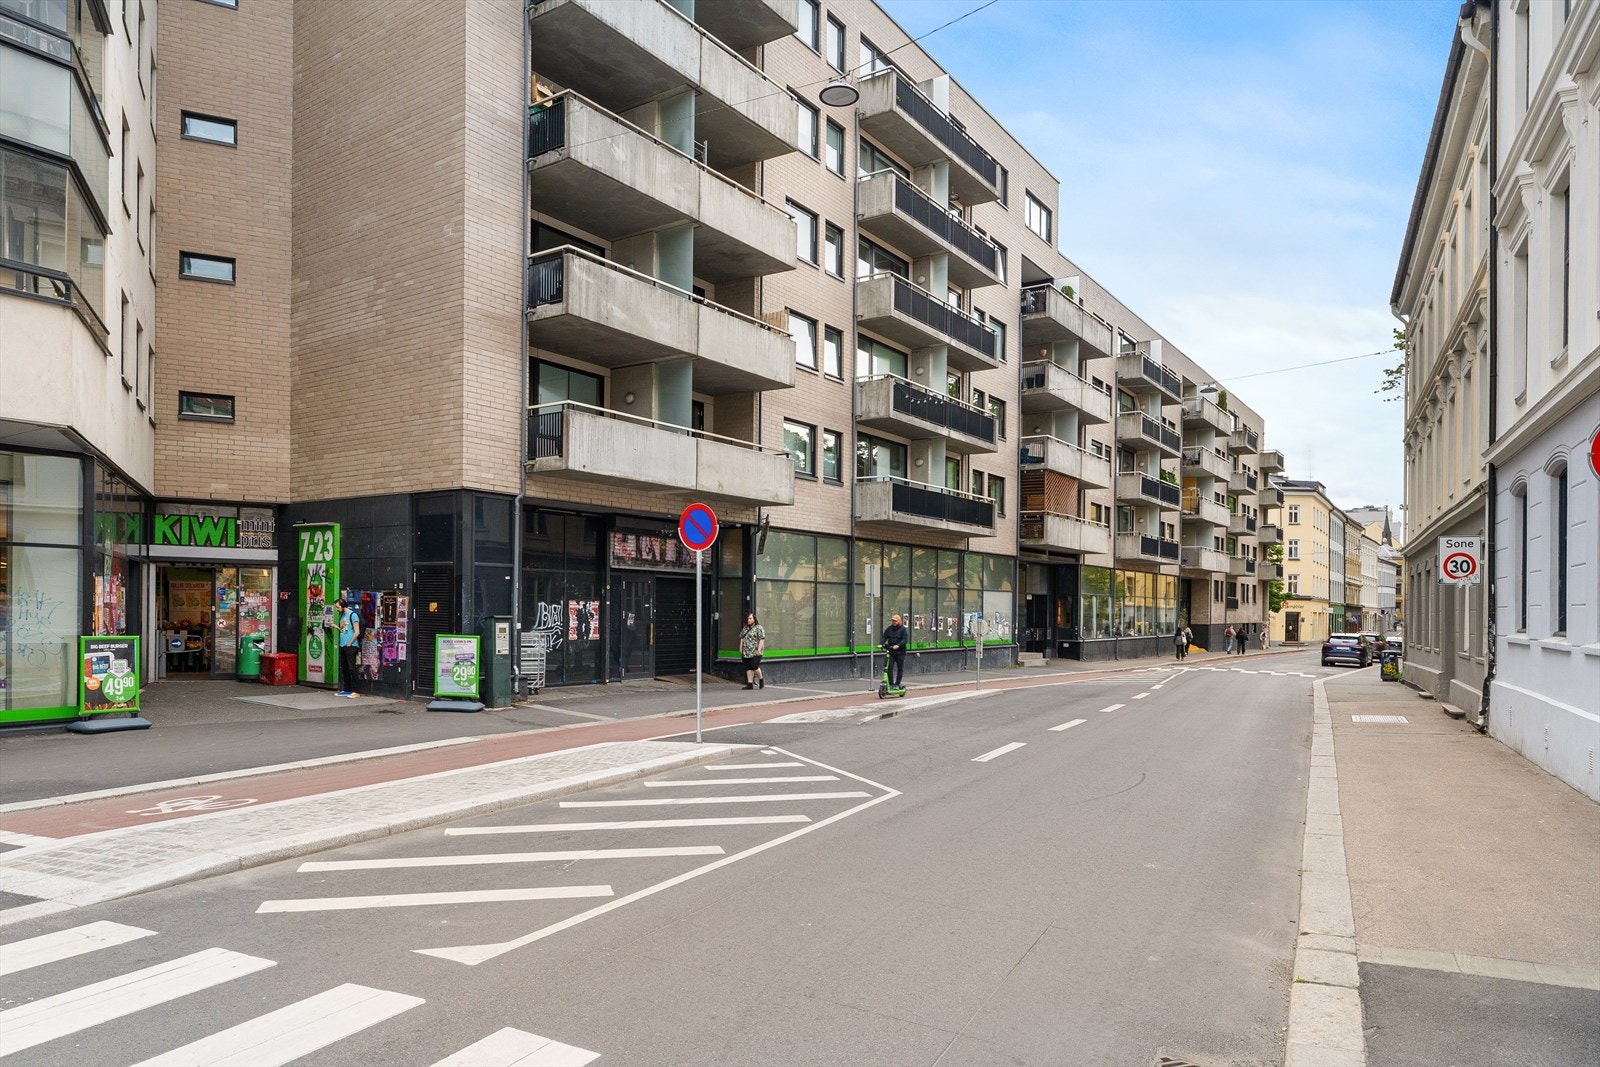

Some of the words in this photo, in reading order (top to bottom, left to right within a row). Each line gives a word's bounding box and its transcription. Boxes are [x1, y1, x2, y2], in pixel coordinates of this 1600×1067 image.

[153, 513, 237, 547] KIWI
[241, 517, 275, 533] mini
[241, 533, 272, 548] pris
[300, 530, 334, 561] 7-23
[1446, 539, 1474, 548] Sone
[1450, 559, 1470, 573] 30
